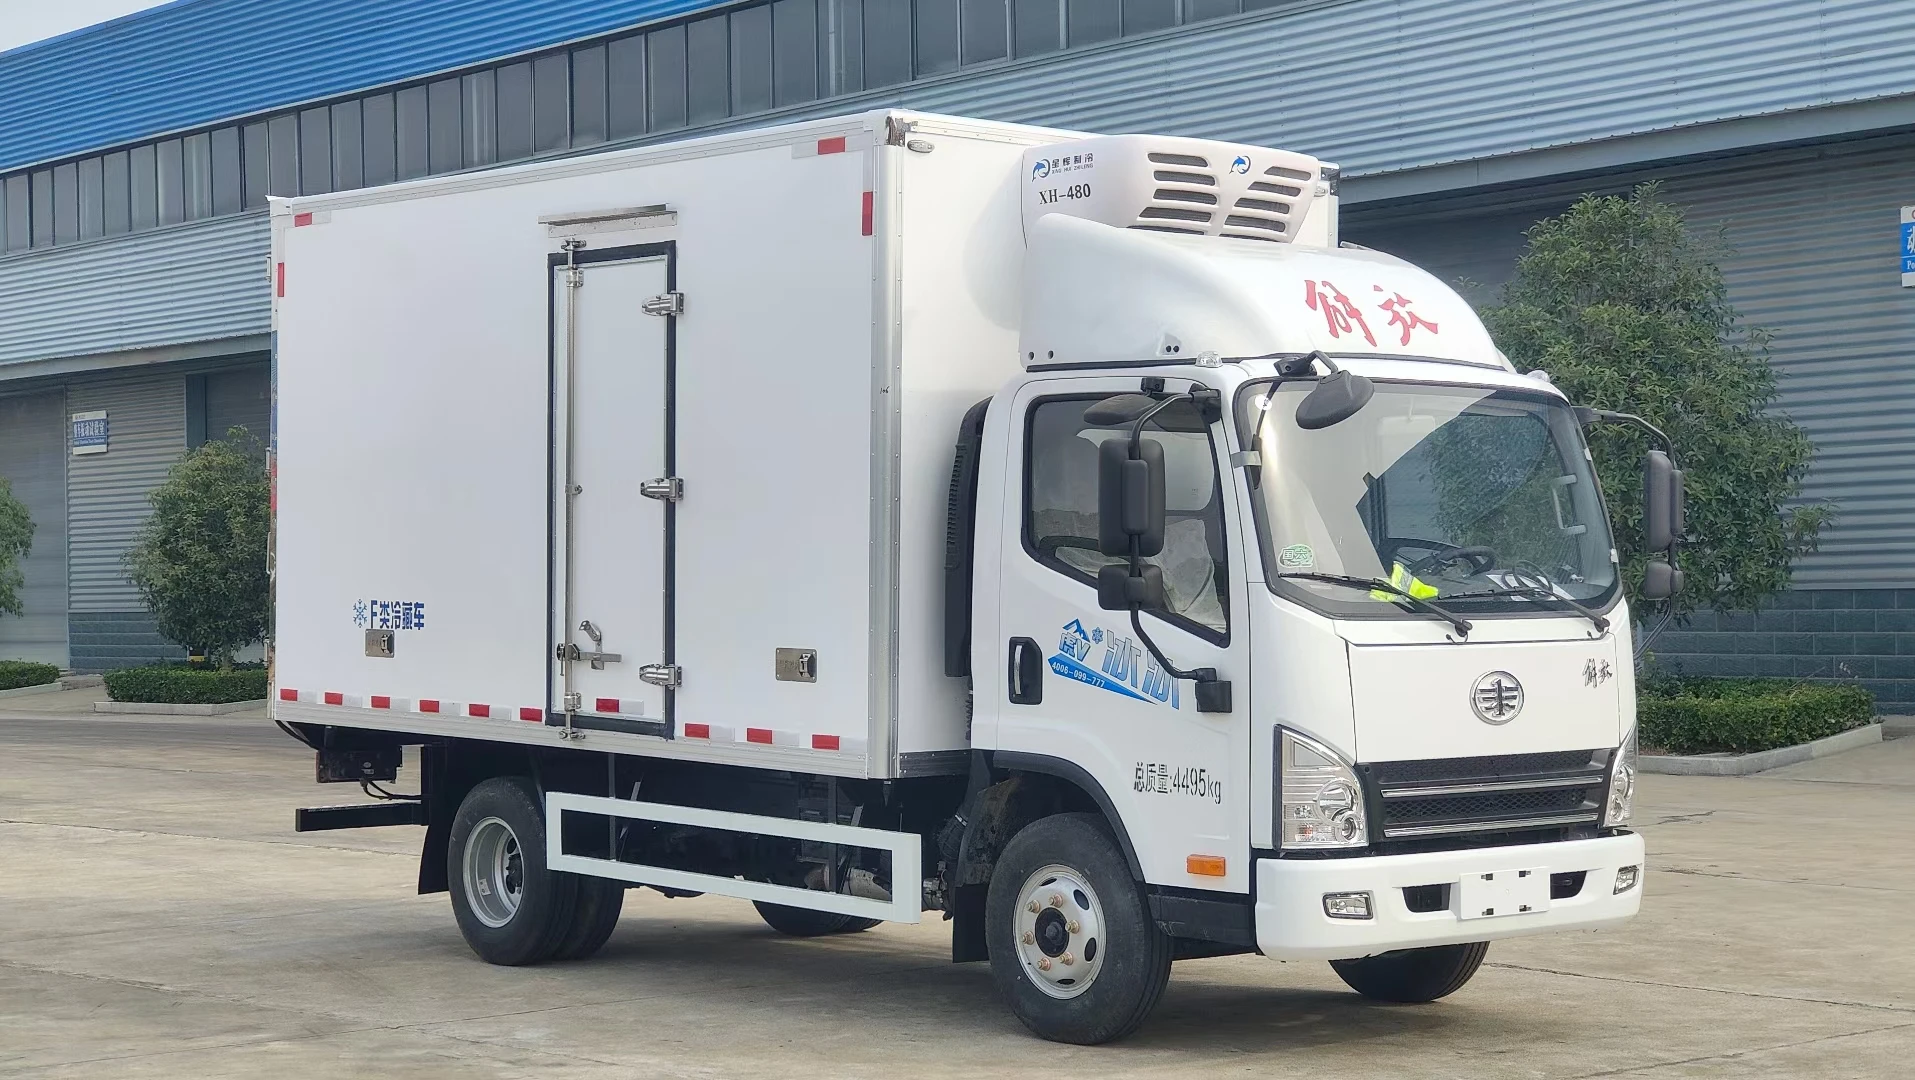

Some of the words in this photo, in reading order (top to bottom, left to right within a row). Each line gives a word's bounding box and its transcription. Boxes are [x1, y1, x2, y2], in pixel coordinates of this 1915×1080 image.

[1039, 183, 1091, 204] XH-480
[1283, 549, 1308, 560] 国六
[370, 600, 425, 631] F类冷藏车
[1051, 661, 1106, 688] 4006-099-777
[1133, 761, 1222, 805] 总质量:4495kg
